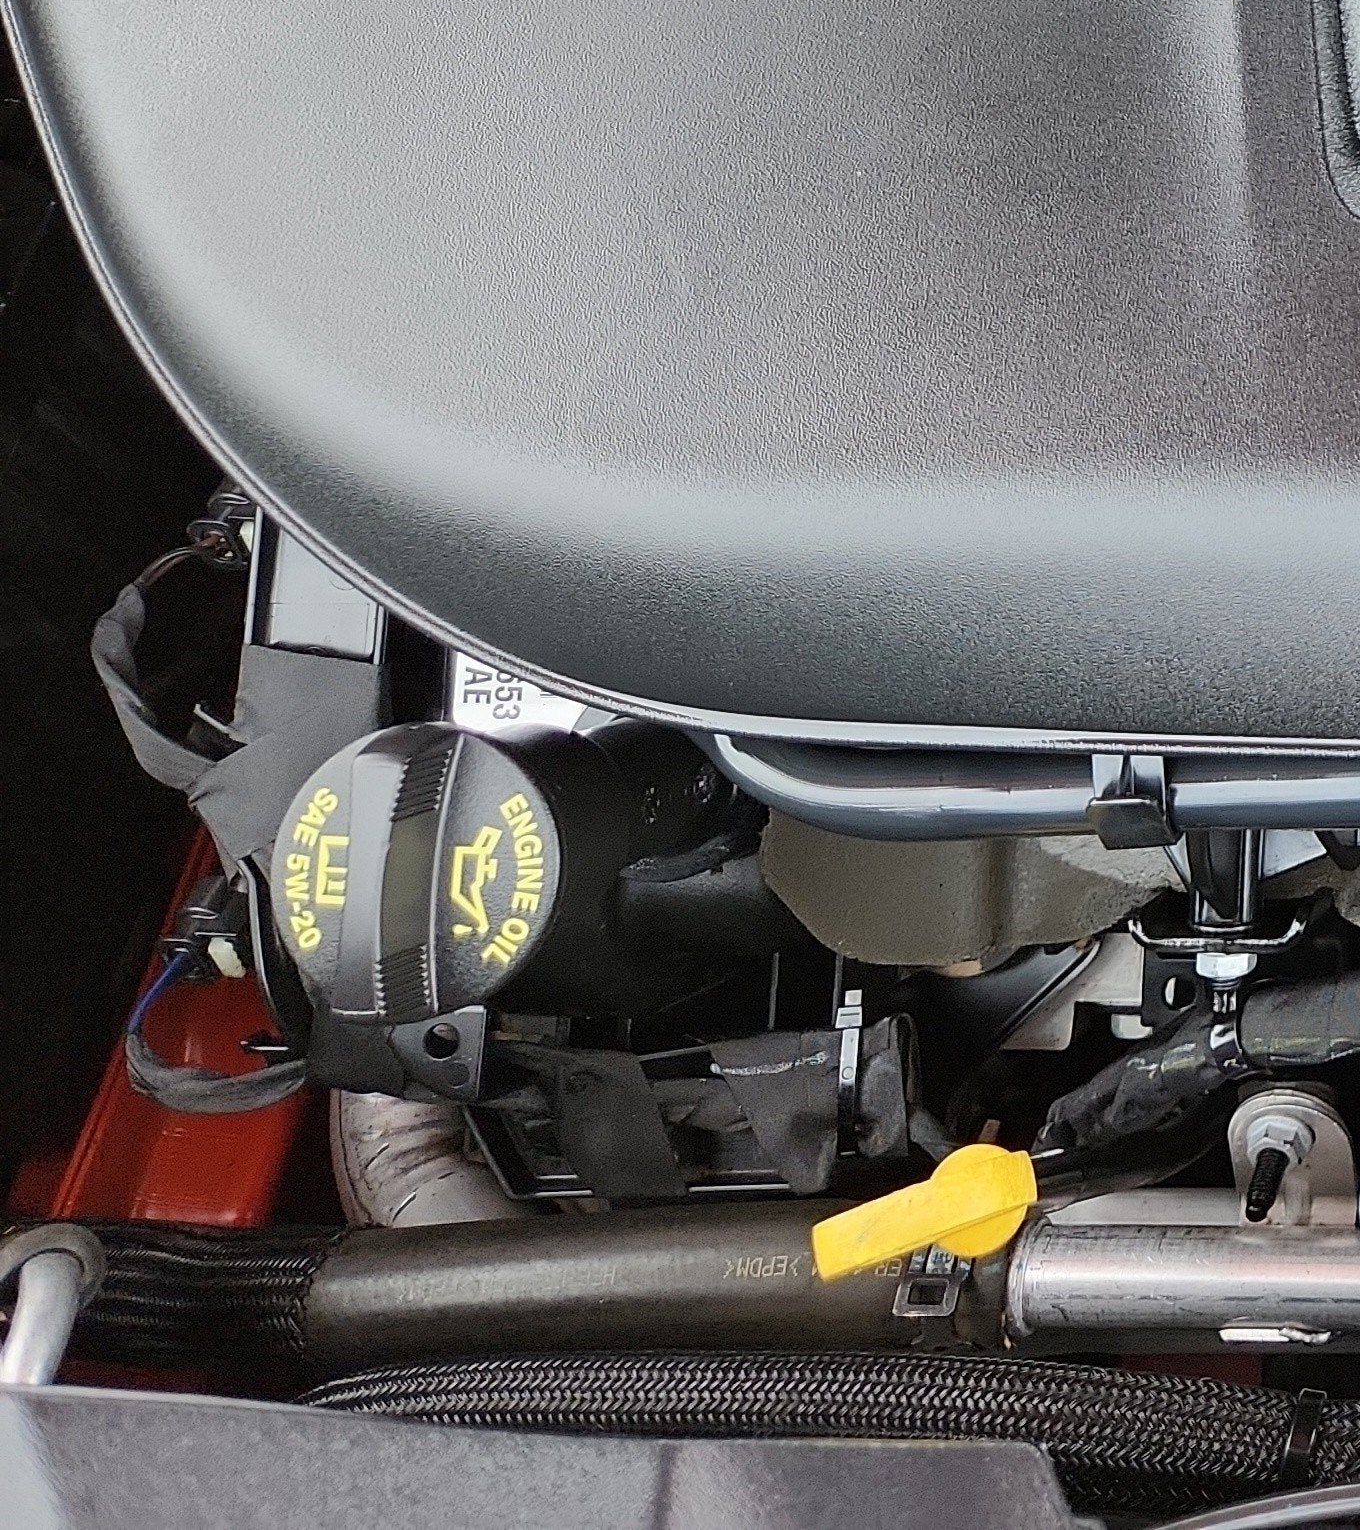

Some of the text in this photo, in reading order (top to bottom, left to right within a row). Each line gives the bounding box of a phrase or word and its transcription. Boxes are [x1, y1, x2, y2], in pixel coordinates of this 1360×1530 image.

[462, 666, 493, 705] AE
[285, 787, 339, 950] SAE 5W-20
[480, 793, 544, 966] ENGINE OIL
